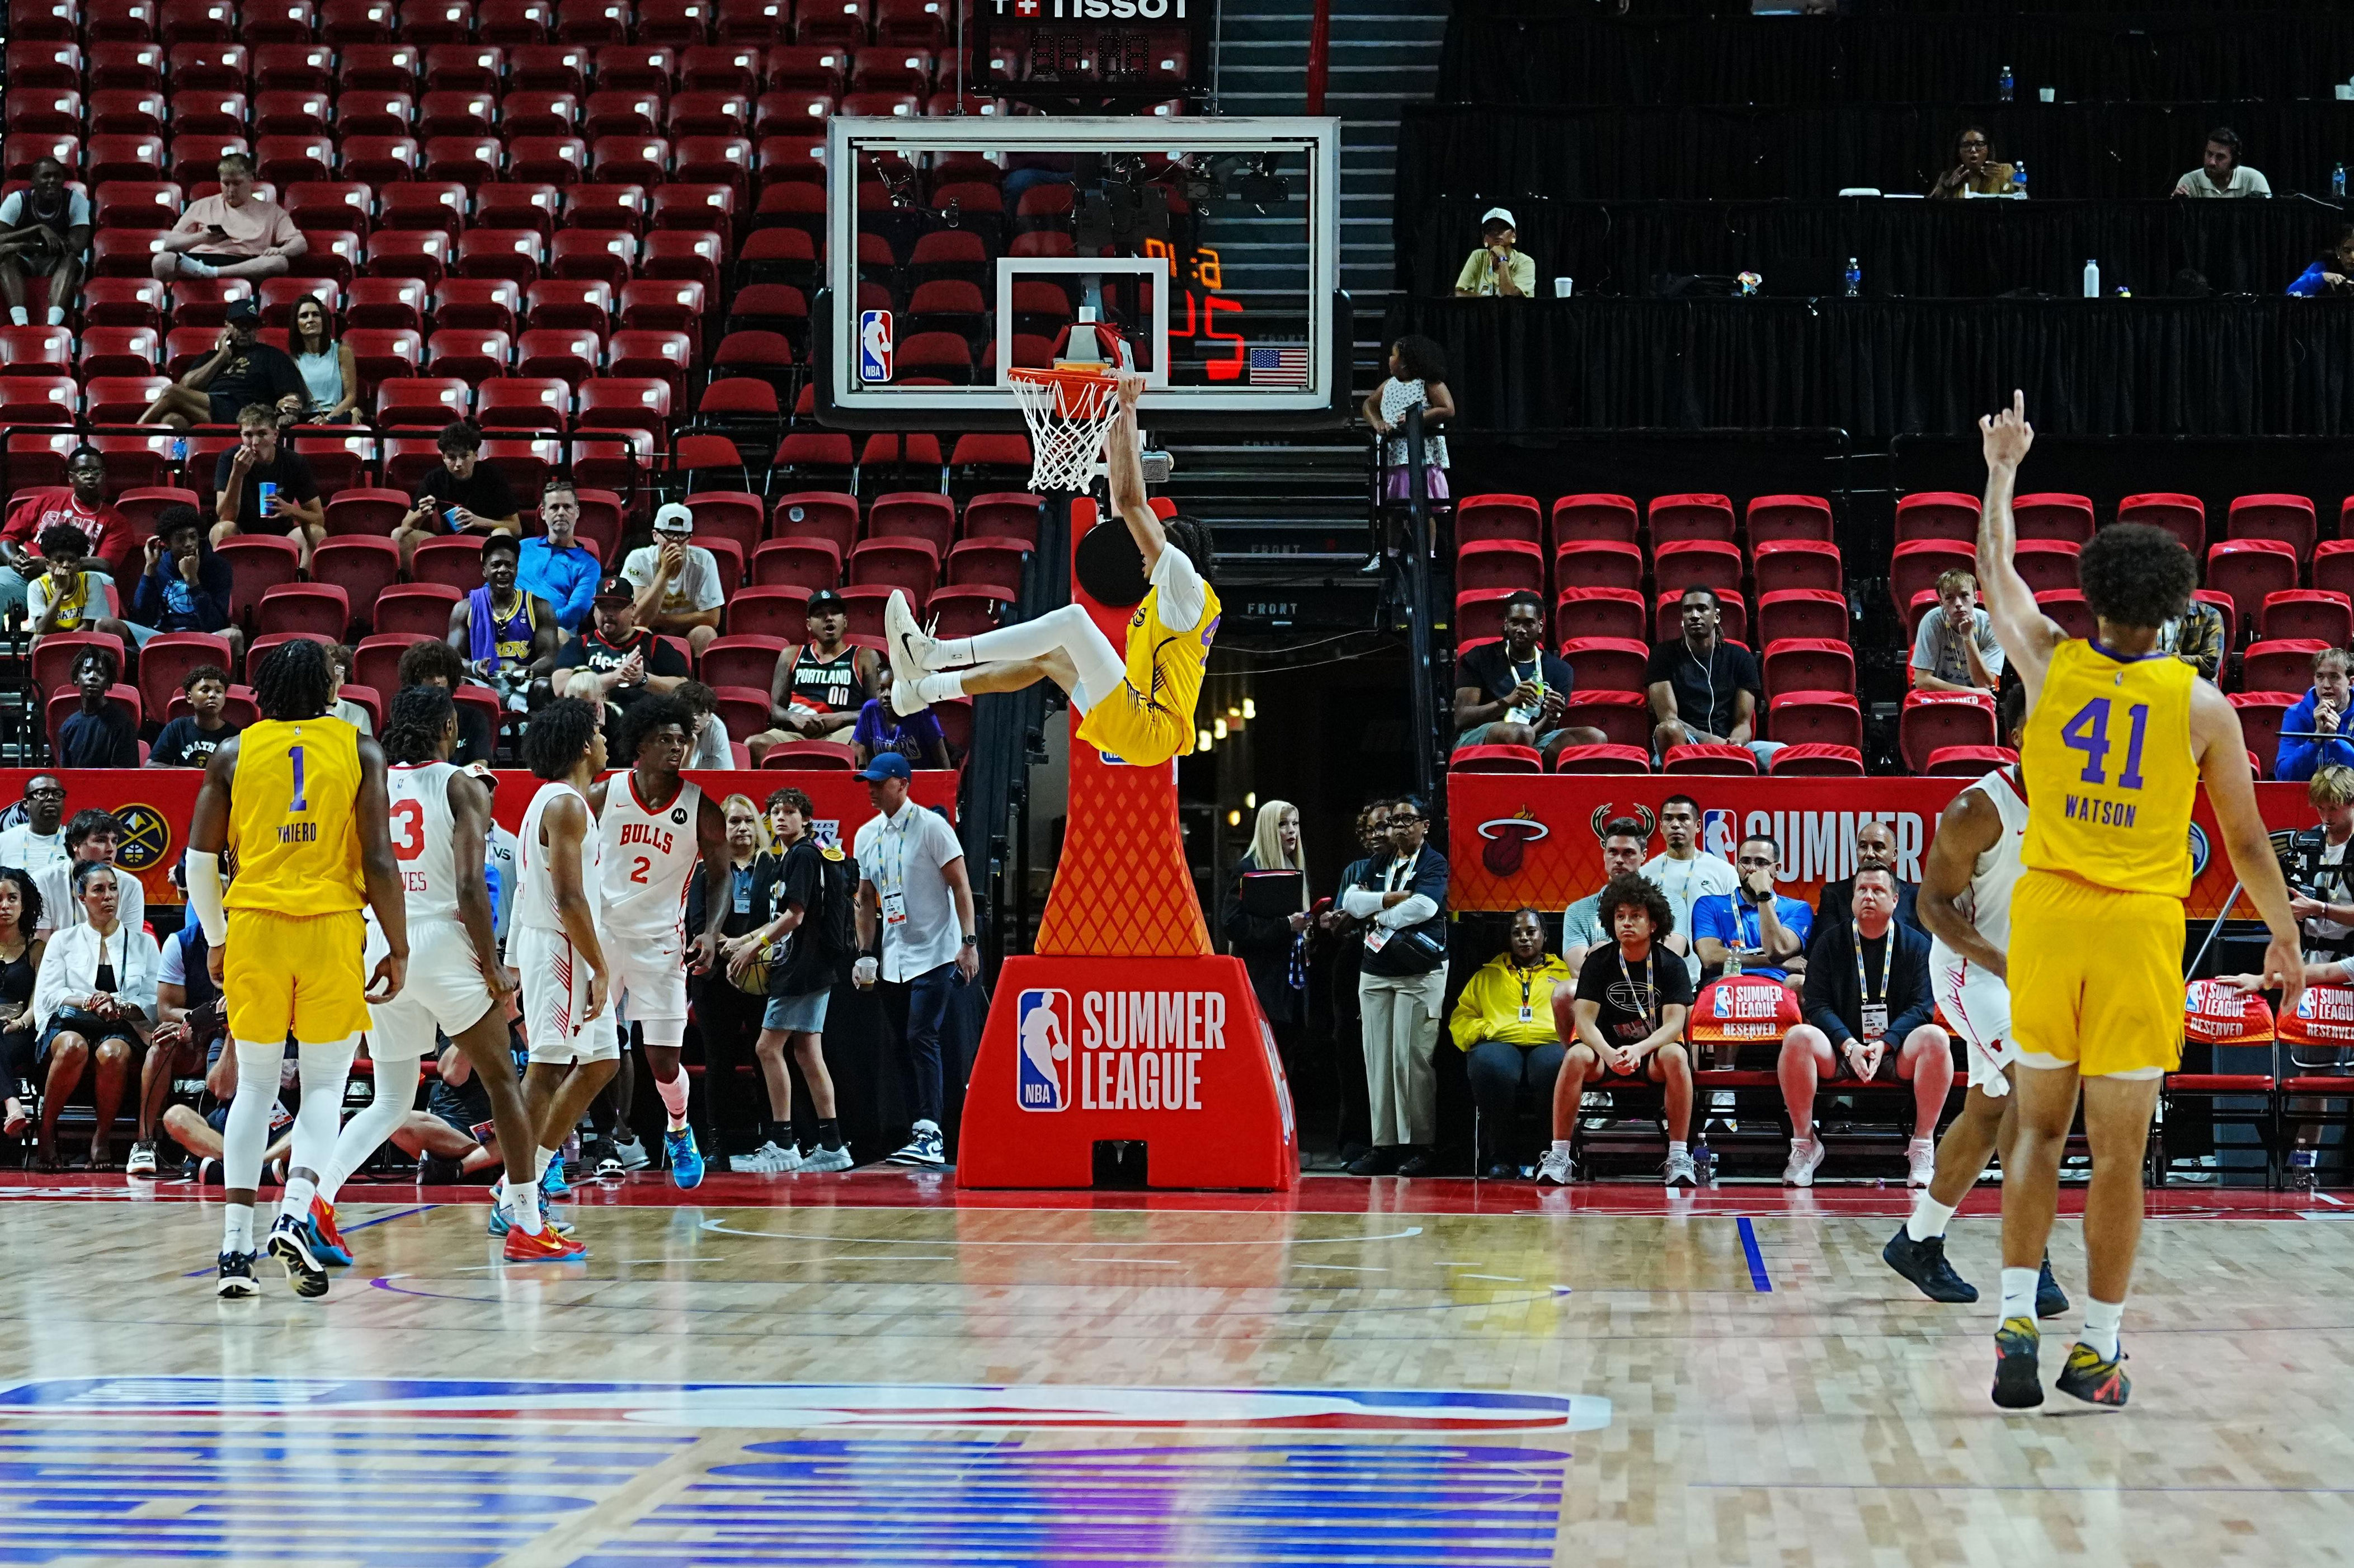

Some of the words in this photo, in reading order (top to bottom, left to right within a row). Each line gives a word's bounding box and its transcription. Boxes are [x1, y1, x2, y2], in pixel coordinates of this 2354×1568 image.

[865, 365, 881, 377] NBA
[1247, 602, 1297, 615] FRONT
[495, 640, 531, 660] KERS
[588, 651, 632, 671] ripci
[795, 668, 851, 685] PORTLAND
[827, 685, 849, 705] 00
[2061, 697, 2149, 790] 41
[288, 746, 307, 812] 1
[2065, 793, 2136, 828] WATSON
[276, 822, 317, 844] THIERO
[620, 823, 674, 855] BULLS
[630, 856, 651, 884] 2
[1736, 986, 1783, 1002] SUMMER
[2319, 988, 2354, 1006] SUMM
[1735, 1001, 1778, 1018] LEAGUE
[2205, 999, 2246, 1018] LEAGUE
[2319, 1004, 2354, 1021] LEAGU
[1082, 991, 1226, 1049] SUMMER
[1723, 1023, 1776, 1036] RESERVED
[2190, 1016, 2244, 1037] RESERVED
[1082, 1052, 1202, 1110] LEAGUE
[1025, 1084, 1051, 1104] NBA
